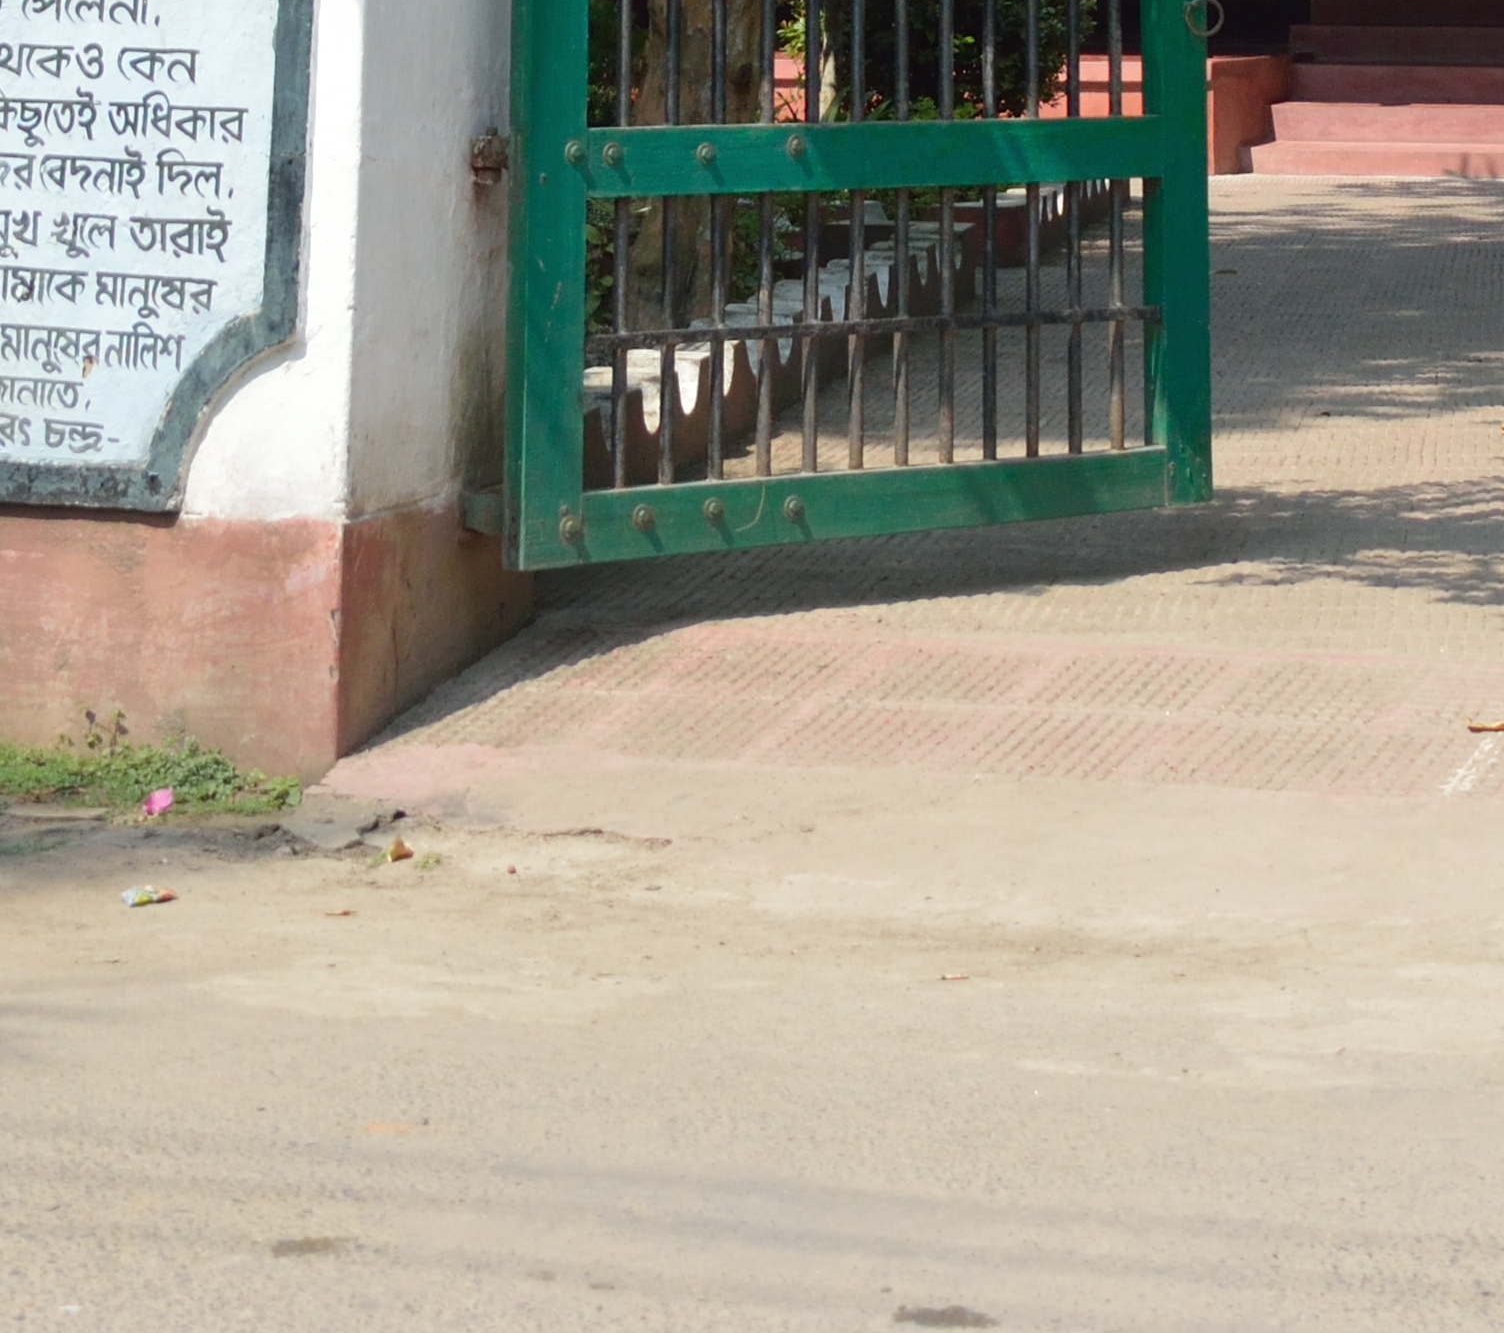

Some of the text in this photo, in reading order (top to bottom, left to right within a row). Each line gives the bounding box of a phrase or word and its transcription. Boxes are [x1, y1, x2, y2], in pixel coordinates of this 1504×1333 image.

[116, 46, 201, 85] কেন
[107, 89, 250, 145] অধিকার
[39, 144, 148, 200] বেদনাই
[50, 211, 119, 259] খুলে
[128, 205, 233, 264] তারাই
[94, 271, 219, 320] মানুষের
[104, 321, 186, 372] নালিশ
